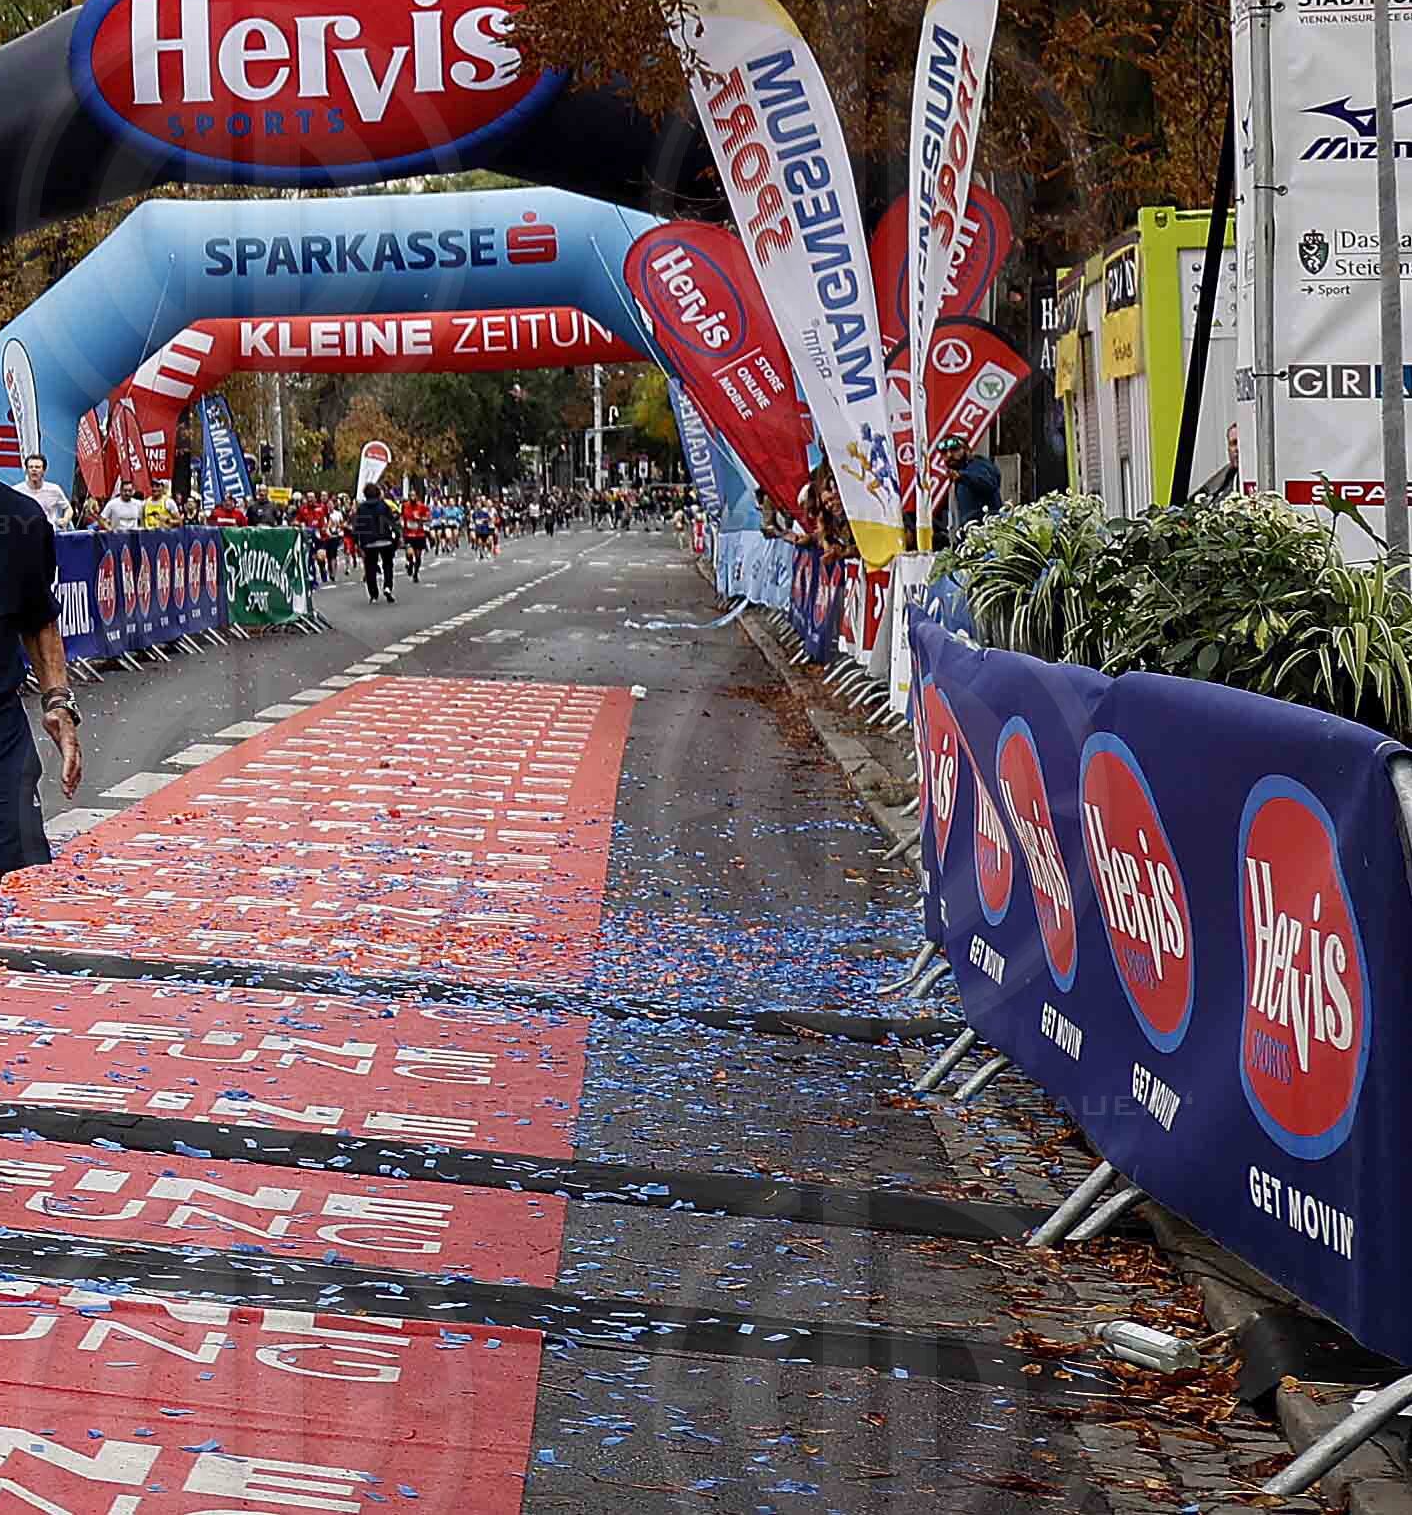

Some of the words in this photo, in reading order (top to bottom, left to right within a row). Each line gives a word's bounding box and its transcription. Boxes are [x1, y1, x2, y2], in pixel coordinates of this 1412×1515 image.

[1299, 13, 1338, 25] VIENNA
[166, 108, 345, 141] SPORTS
[204, 226, 497, 278] SPARKASSE
[1340, 230, 1379, 250] Das
[652, 244, 732, 350] Hervis
[1317, 284, 1351, 299] Sport
[239, 316, 434, 357] KLEINE
[736, 366, 771, 411] ONLINE
[753, 354, 785, 395] STORE
[718, 374, 753, 423] MOBILE
[1083, 801, 1184, 981] Hervis
[1245, 857, 1353, 1073] Hervis
[1040, 1001, 1057, 1041] GET
[1250, 1028, 1292, 1085] SPORTS
[1132, 1061, 1153, 1103] GET
[1249, 1165, 1283, 1216] GET
